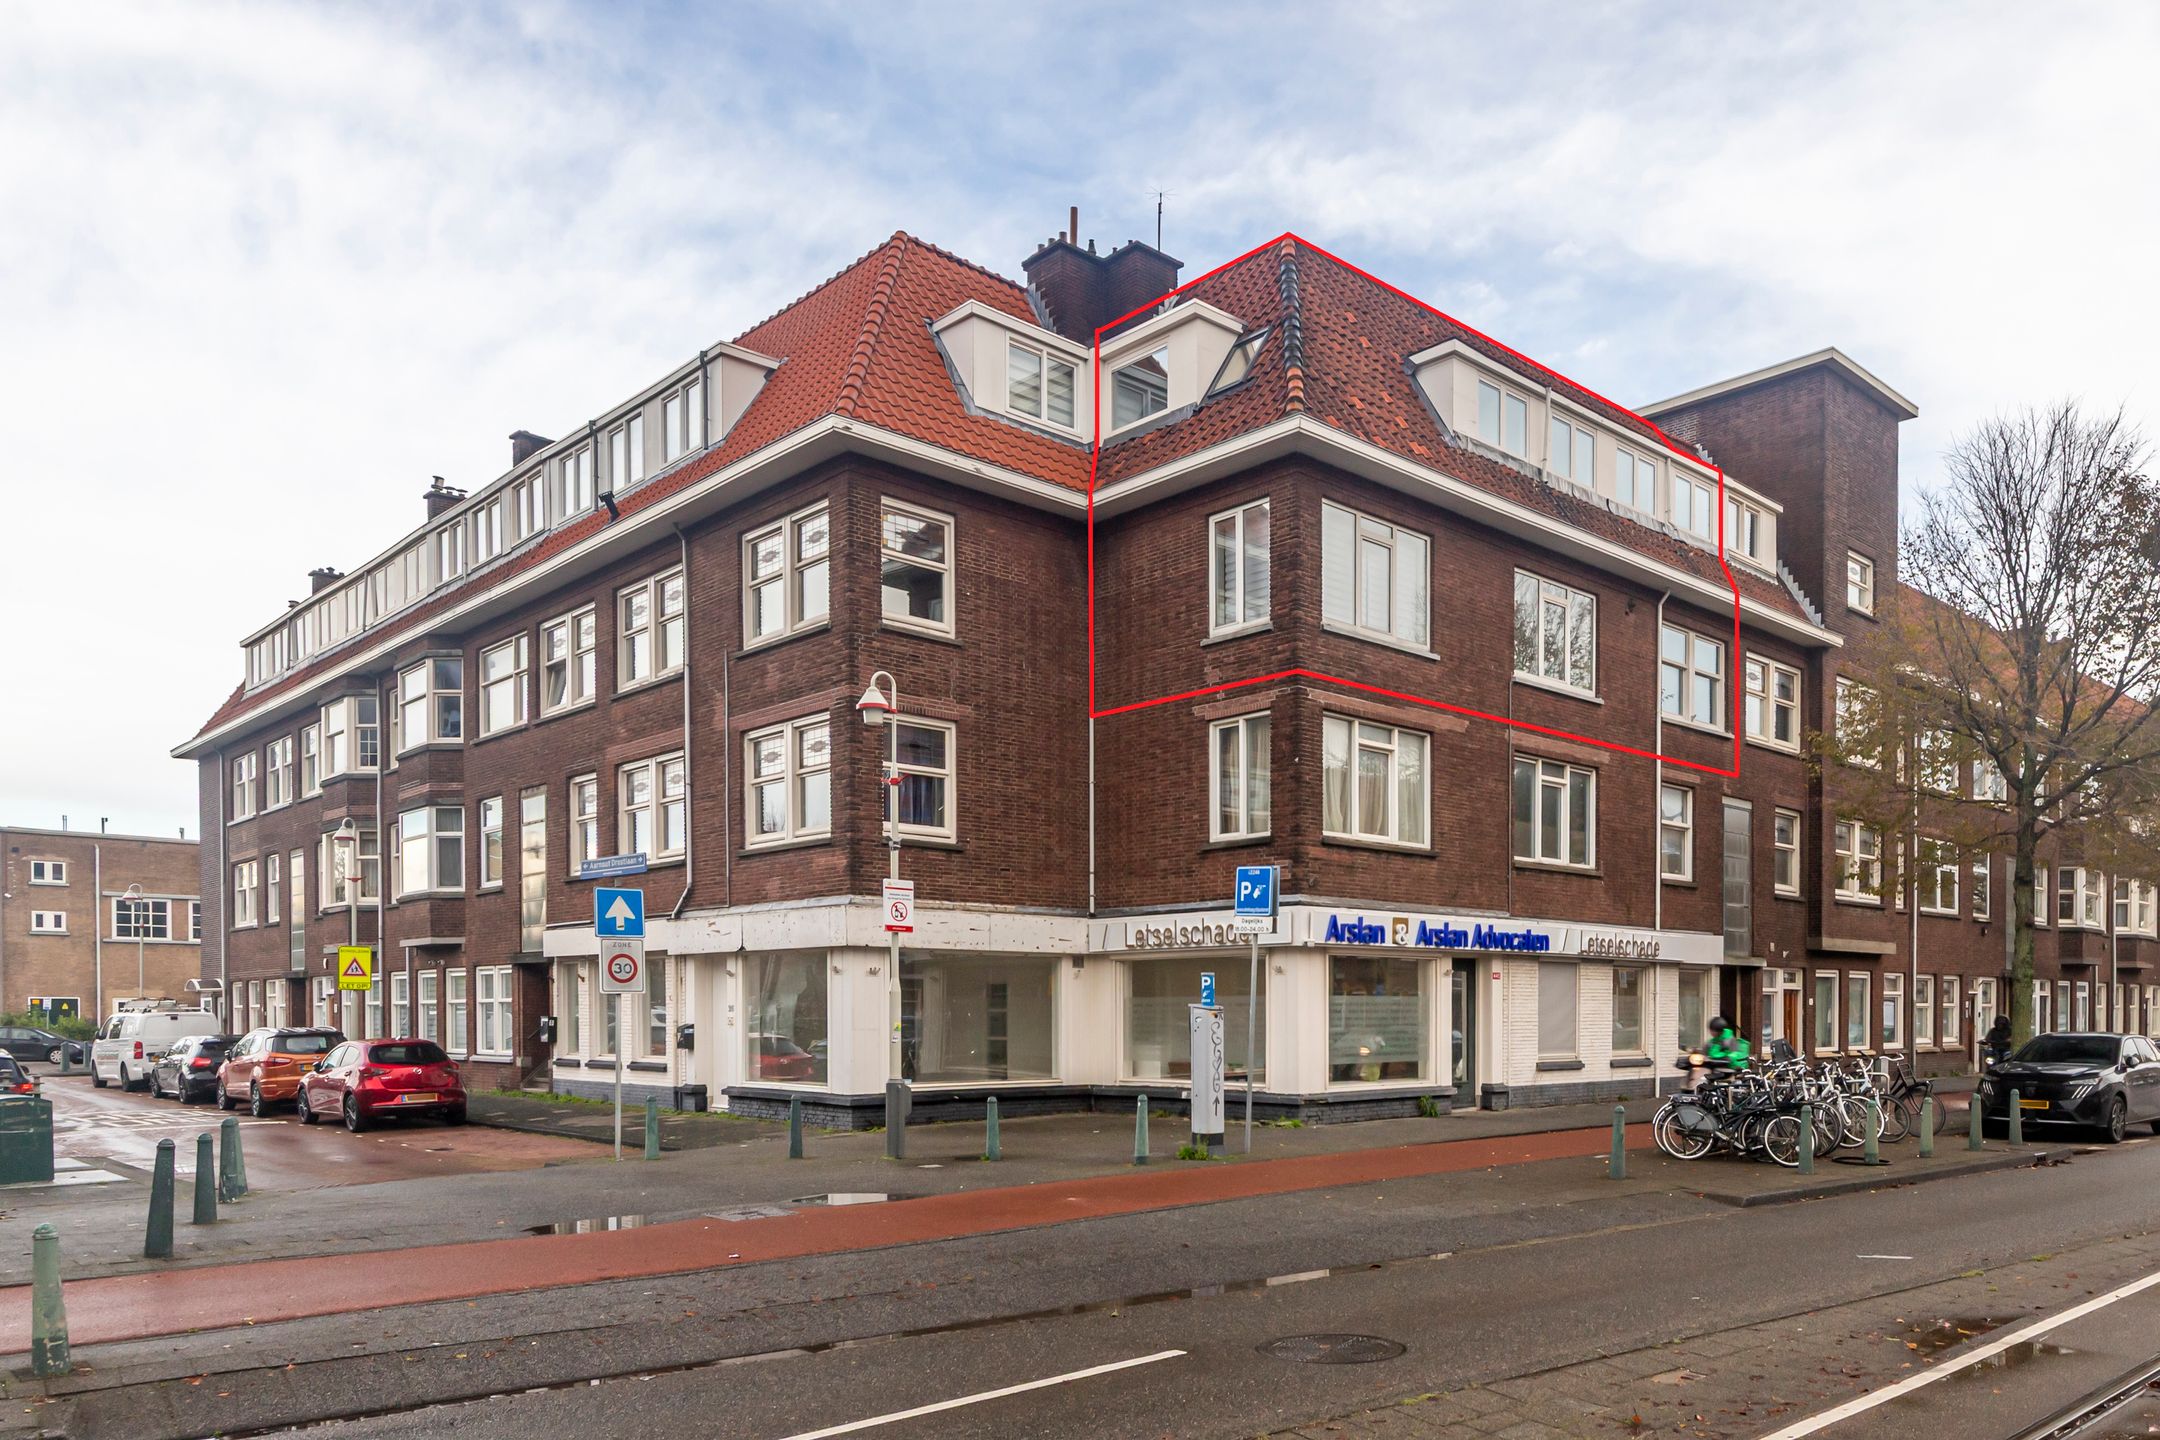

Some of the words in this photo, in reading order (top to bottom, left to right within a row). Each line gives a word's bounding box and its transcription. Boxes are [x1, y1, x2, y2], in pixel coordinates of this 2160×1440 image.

[1240, 881, 1252, 902] P
[1325, 914, 1386, 944] Arslan
[1395, 923, 1408, 946] &
[1415, 920, 1469, 948] Arslan
[1471, 923, 1550, 952] Advocaten
[1580, 929, 1660, 959] Letselschade
[613, 963, 632, 974] 30
[1202, 976, 1211, 990] P
